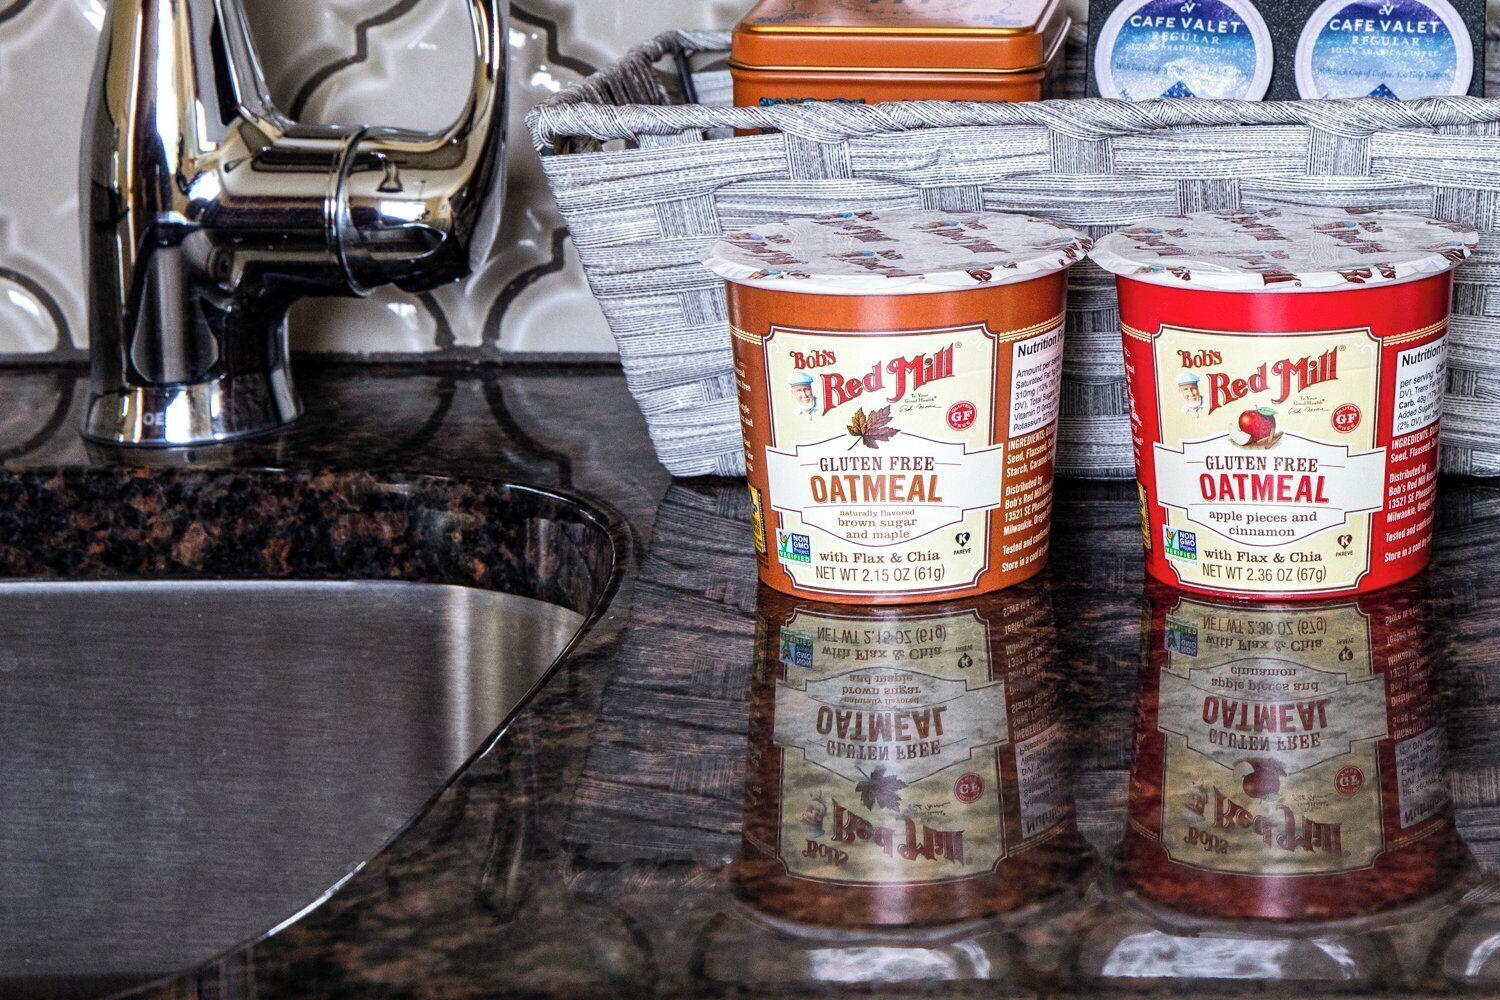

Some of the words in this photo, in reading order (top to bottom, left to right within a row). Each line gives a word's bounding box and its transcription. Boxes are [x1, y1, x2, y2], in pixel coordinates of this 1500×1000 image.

[1130, 15, 1176, 28] CAFE
[1181, 17, 1241, 33] VALET
[1329, 19, 1375, 32] CAFE
[1380, 20, 1440, 33] VALET
[1152, 31, 1220, 45] REGULAR
[1351, 36, 1420, 46] REGULAR
[1018, 336, 1059, 358] Nutrition
[789, 350, 836, 370] Bob's
[1177, 349, 1223, 369] Bob's
[1402, 345, 1440, 367] Nutrition
[1016, 364, 1041, 379] Amount
[820, 361, 885, 416] Red
[886, 343, 955, 403] Mill
[1206, 362, 1270, 415] Red
[1271, 345, 1339, 404] Mill
[1400, 378, 1412, 389] per
[951, 410, 972, 422] GF
[1014, 408, 1035, 421] Vitamin
[1336, 413, 1357, 424] GF
[1397, 408, 1417, 420] Added
[1008, 429, 1045, 451] INGREDIENTS:
[1391, 429, 1430, 450] INGREDIENTS:
[819, 456, 882, 472] GLUTEN
[889, 456, 935, 472] FREE
[1205, 456, 1267, 471] GLUTEN
[1273, 457, 1318, 473] FREE
[1389, 467, 1422, 484] Distributed
[810, 474, 943, 504] OATMEAL
[1006, 480, 1036, 496] Distributed
[1199, 473, 1329, 504] OATMEAL
[1388, 483, 1406, 497] Bob's
[1407, 480, 1417, 492] Red
[1005, 496, 1022, 510] Bob's
[1023, 492, 1033, 503] Red
[1388, 496, 1407, 509] 13521
[1408, 493, 1415, 503] SE
[1004, 508, 1023, 523] 13521
[1024, 505, 1031, 515] SE
[1209, 511, 1243, 522] apple
[1246, 512, 1288, 524] pieces
[1292, 512, 1317, 522] and
[838, 518, 876, 527] brown
[880, 519, 918, 530] sugar
[1229, 526, 1296, 537] cinnamon
[793, 534, 809, 543] NON
[846, 530, 868, 539] and
[872, 530, 910, 541] maple
[1180, 532, 1194, 540] NON
[1385, 530, 1406, 543] Tested
[1406, 525, 1416, 536] and
[793, 541, 809, 550] GMO
[1003, 541, 1022, 556] Tested
[1023, 536, 1032, 548] and
[1180, 539, 1195, 547] GMO
[779, 550, 810, 562] VERIFIED
[819, 552, 848, 562] with
[853, 553, 885, 564] Flax
[890, 553, 902, 563] &
[907, 551, 940, 562] Chia
[1166, 547, 1196, 560] VERIFIED
[1204, 549, 1232, 561] with
[1236, 551, 1268, 563] Flax
[1273, 553, 1285, 563] &
[1289, 552, 1322, 563] Chia
[1384, 550, 1401, 563] Store
[816, 565, 836, 580] NET
[840, 568, 858, 581] WT
[862, 569, 889, 582] 2.15
[893, 568, 910, 581] OZ
[914, 564, 945, 581] (61g)
[1002, 559, 1018, 573] Store
[1202, 564, 1222, 578] NET
[1225, 567, 1243, 581] WT
[1246, 568, 1272, 582] 2.36
[1277, 568, 1293, 582] OZ
[1296, 565, 1327, 582] (67g)
